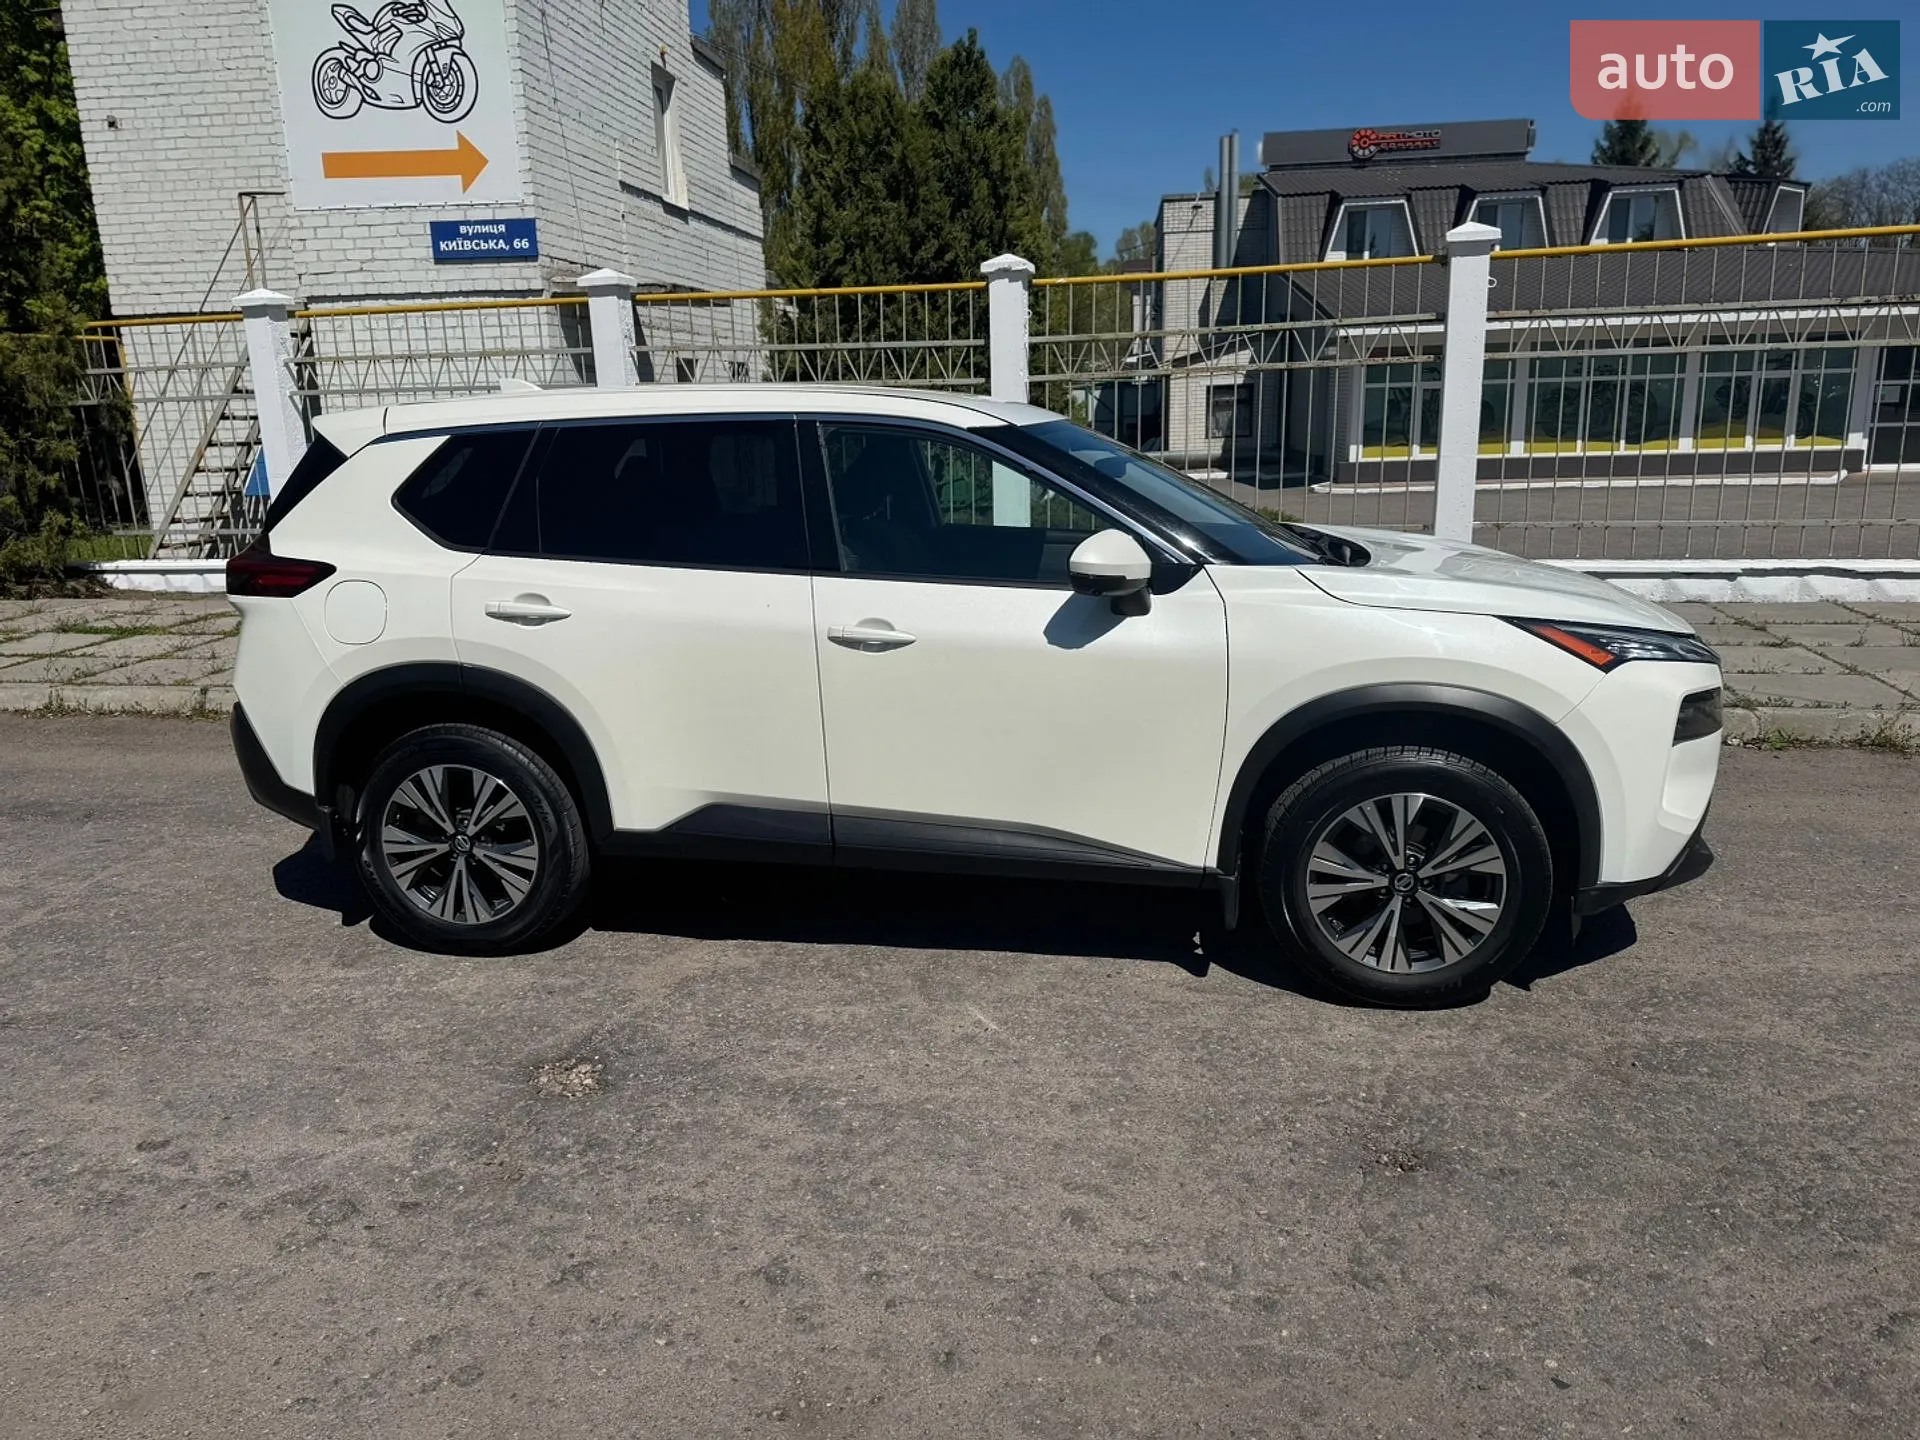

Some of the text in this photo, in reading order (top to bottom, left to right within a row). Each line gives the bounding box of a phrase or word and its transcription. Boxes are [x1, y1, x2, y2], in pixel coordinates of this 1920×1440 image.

[459, 224, 505, 235] вулиця
[439, 237, 529, 251] КИЇВСЬКА, 66
